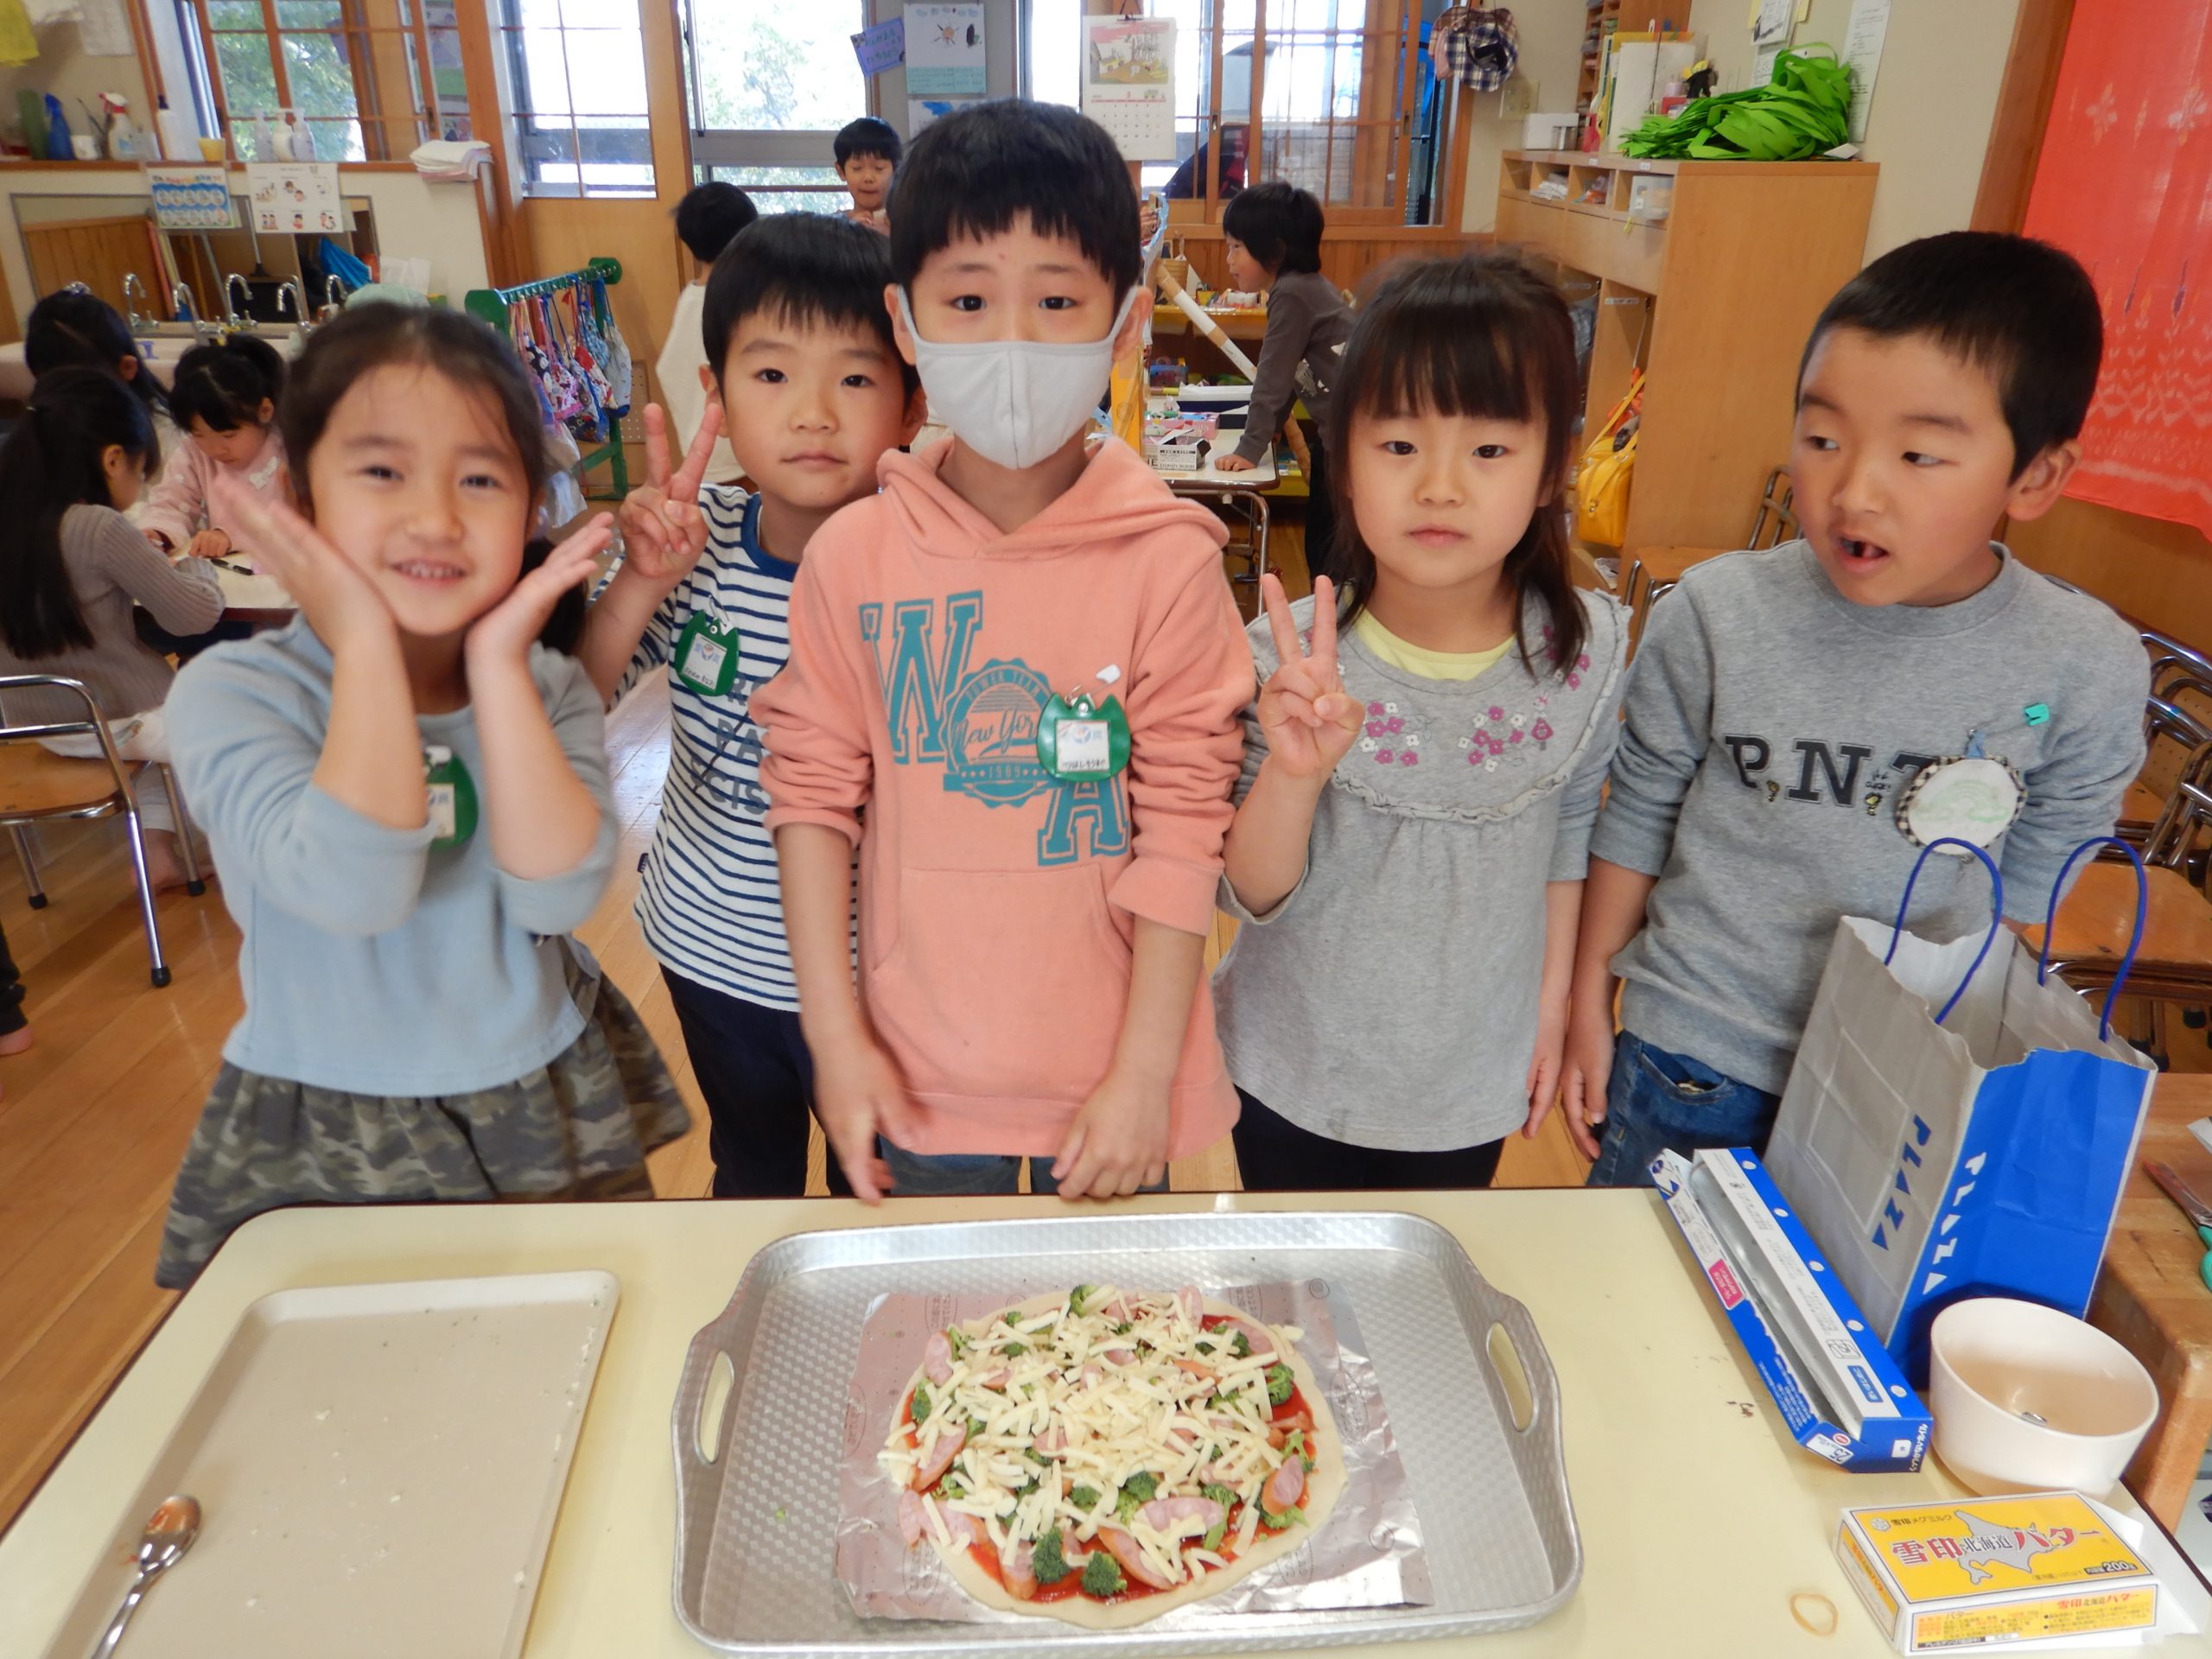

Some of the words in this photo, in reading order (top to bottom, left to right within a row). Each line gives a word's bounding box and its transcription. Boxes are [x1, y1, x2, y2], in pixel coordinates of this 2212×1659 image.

[859, 590, 983, 765] W
[999, 704, 1039, 754] Yor
[1891, 1515, 1953, 1526] 雪印メグミルク
[1891, 1527, 2101, 1565] 雪印北海道バター
